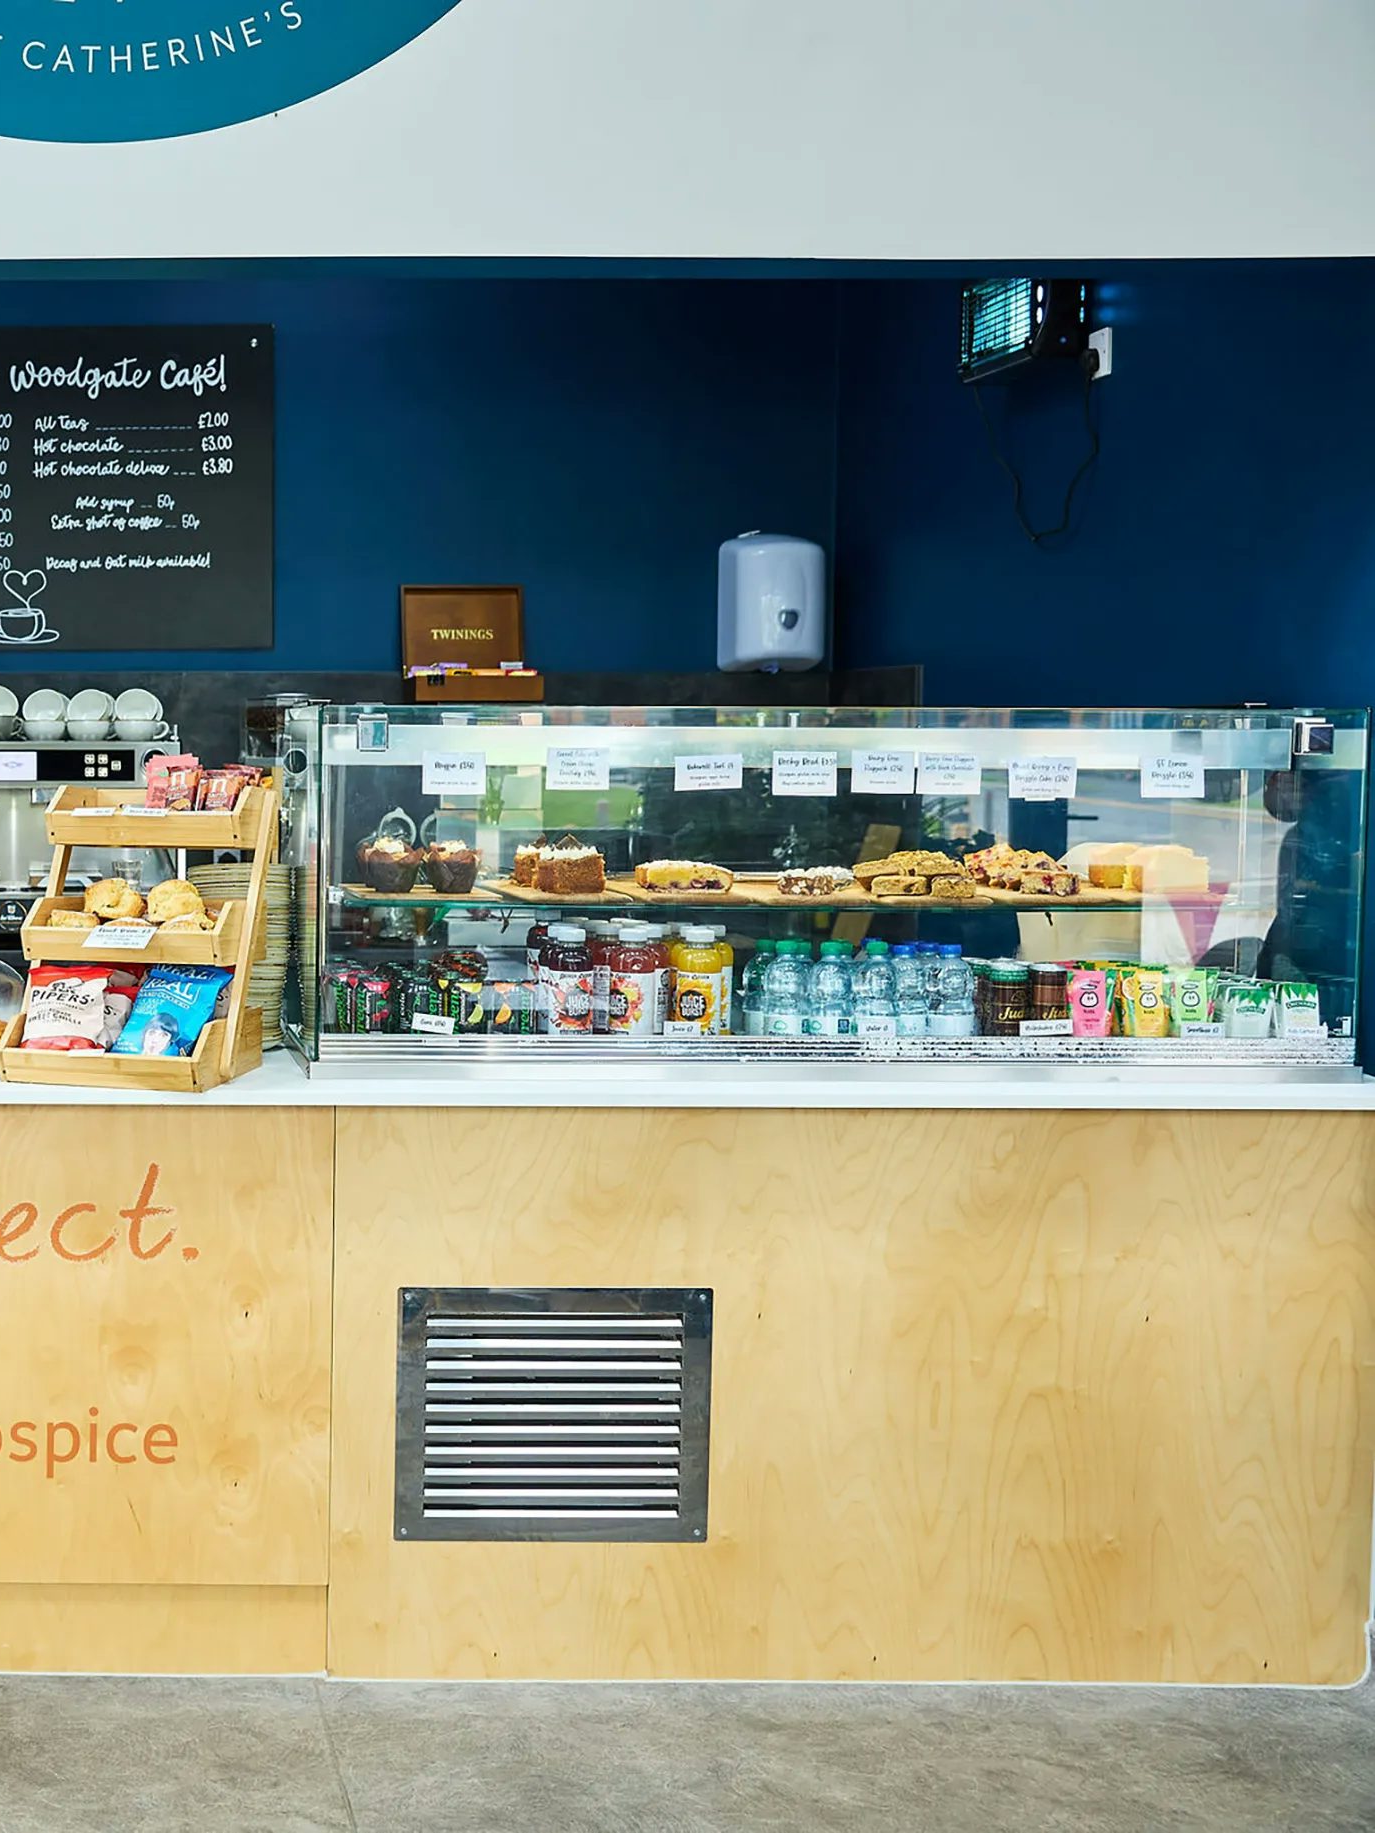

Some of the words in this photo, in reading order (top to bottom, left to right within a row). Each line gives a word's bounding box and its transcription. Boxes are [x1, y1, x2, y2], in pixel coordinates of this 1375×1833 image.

[22, 0, 303, 73] CATHERINE'S
[9, 356, 152, 400] Woodgate
[159, 353, 227, 397] Café!
[34, 415, 57, 433] All
[57, 414, 90, 432] Teas
[32, 437, 59, 457] Hot
[59, 437, 125, 454] chocolate
[200, 434, 233, 453] £3.00
[32, 460, 58, 479] Hot
[60, 460, 124, 477] chocolate
[124, 459, 171, 477] deluxe
[201, 457, 234, 476] £3.80
[75, 495, 100, 510] Add
[99, 498, 135, 514] syrup
[156, 493, 176, 511] 50p
[50, 514, 84, 531] Extra
[85, 513, 112, 532] shot
[110, 515, 127, 532] of
[127, 515, 164, 531] coffee
[181, 513, 201, 531] 50p
[79, 555, 103, 570] and
[128, 554, 156, 569] milk
[155, 551, 211, 569] available!
[431, 629, 494, 640] TWININGS
[680, 993, 706, 1006] JUICE
[681, 1005, 704, 1017] BURST
